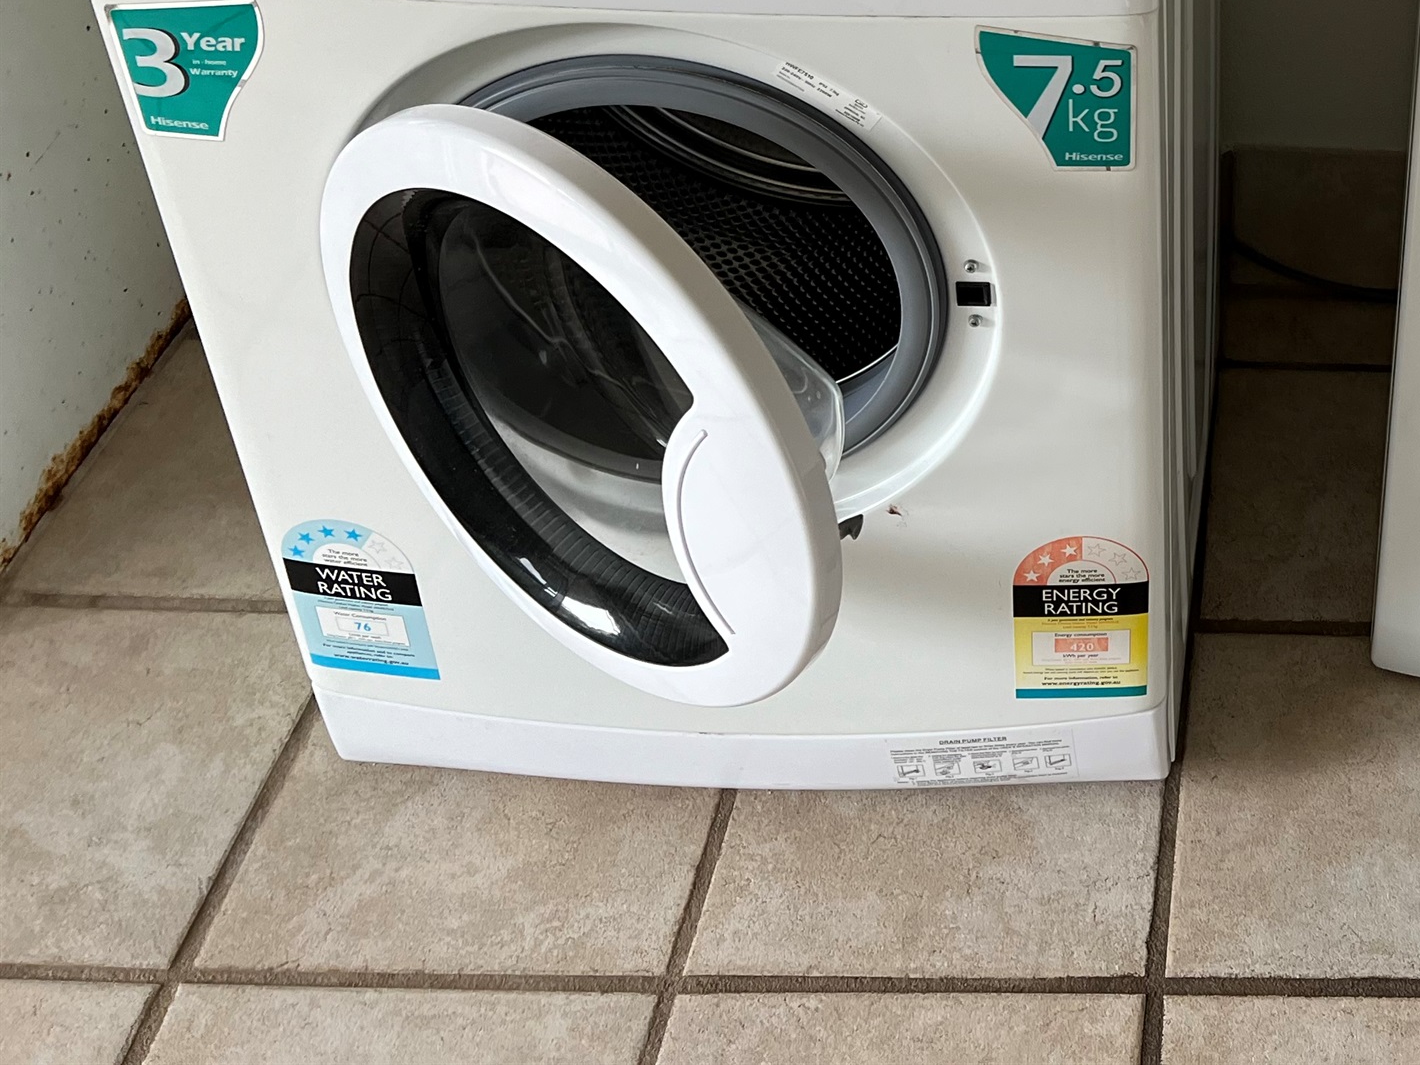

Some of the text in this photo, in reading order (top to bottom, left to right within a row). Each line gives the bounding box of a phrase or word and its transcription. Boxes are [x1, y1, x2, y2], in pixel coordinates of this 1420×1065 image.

[180, 32, 246, 52] Year
[122, 27, 190, 98] 3
[189, 68, 238, 78] Warranty
[150, 116, 210, 130] Hisense
[1068, 98, 1119, 142] kg
[1065, 152, 1124, 161] Hisense
[315, 566, 387, 587] WATER
[317, 581, 393, 601] RATING
[1042, 587, 1121, 601] ENERGY
[1044, 601, 1119, 615] RATING
[354, 621, 372, 632] 76
[1070, 642, 1095, 652] 420
